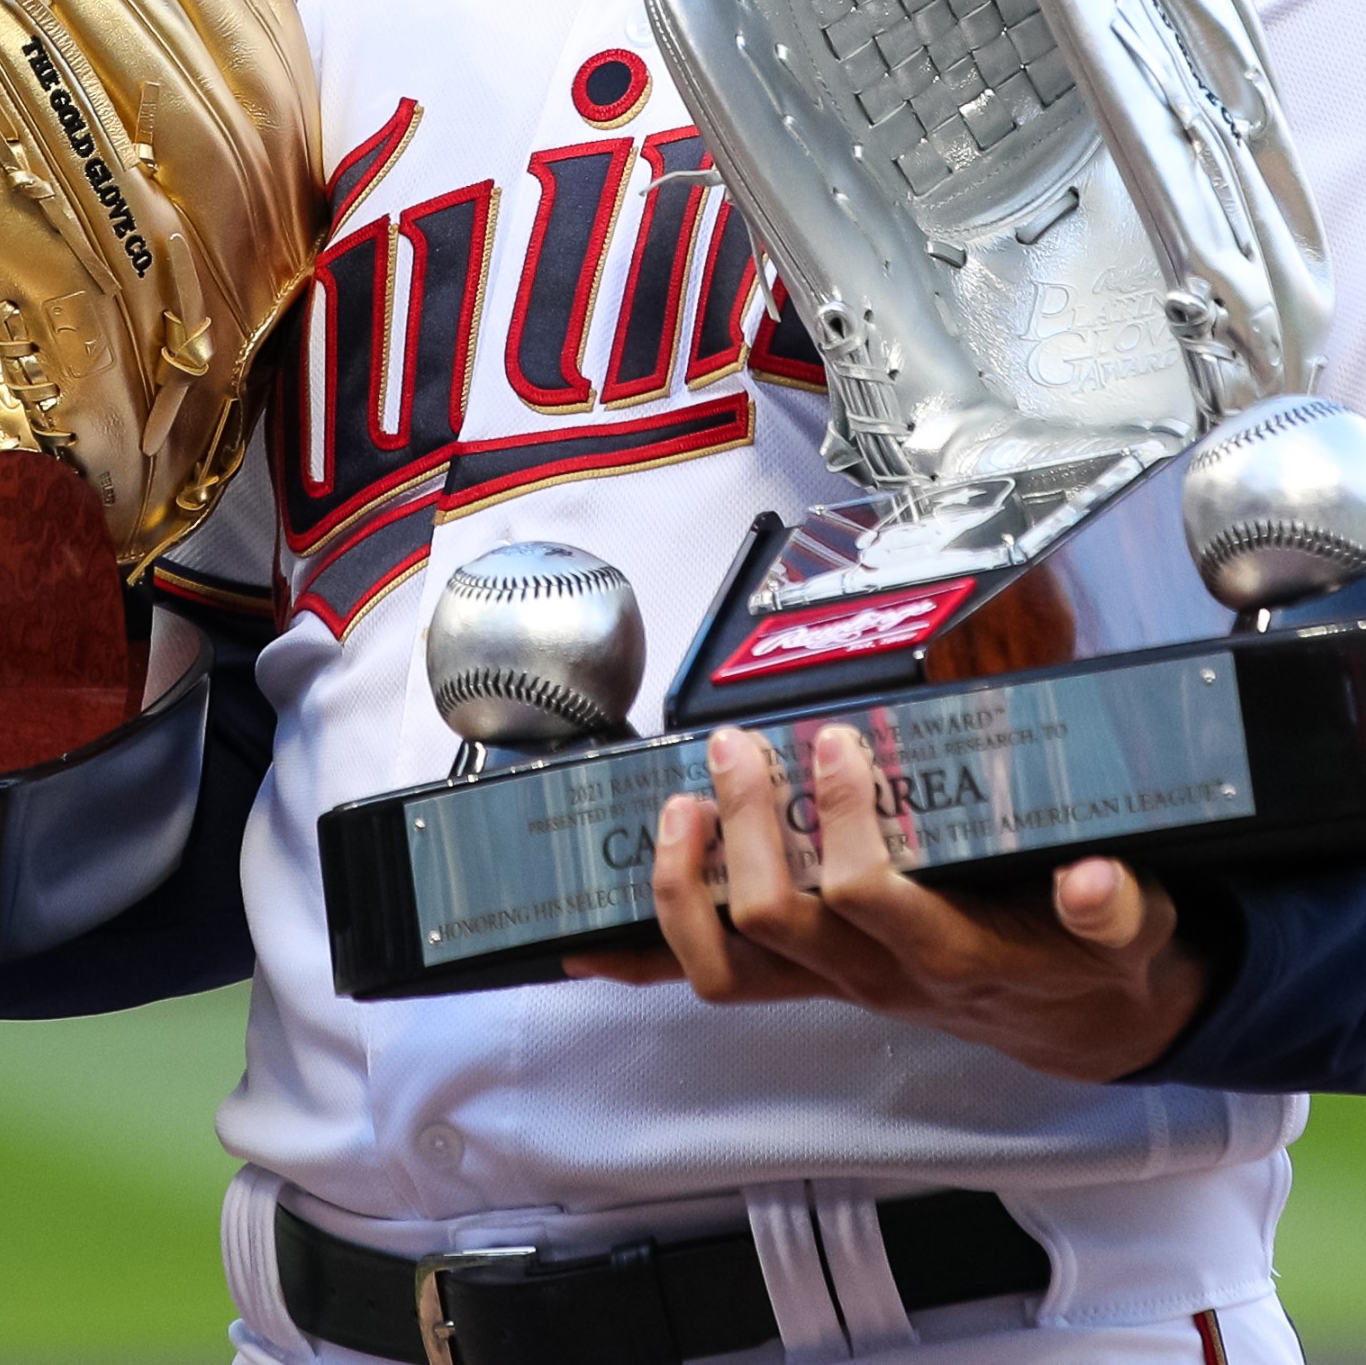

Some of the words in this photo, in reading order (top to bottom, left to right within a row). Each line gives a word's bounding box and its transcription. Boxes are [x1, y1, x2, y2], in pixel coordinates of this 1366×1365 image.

[22, 34, 61, 92] THE
[49, 88, 95, 159] GOLD
[84, 156, 137, 240] GLOVE
[527, 807, 607, 835] PRESENTED
[1043, 723, 1068, 740] TO
[570, 782, 604, 806] 2021
[534, 897, 563, 919] HIS
[566, 881, 653, 913] SELECTIO
[946, 819, 991, 842] THE
[1001, 796, 1119, 833] AMERICAN
